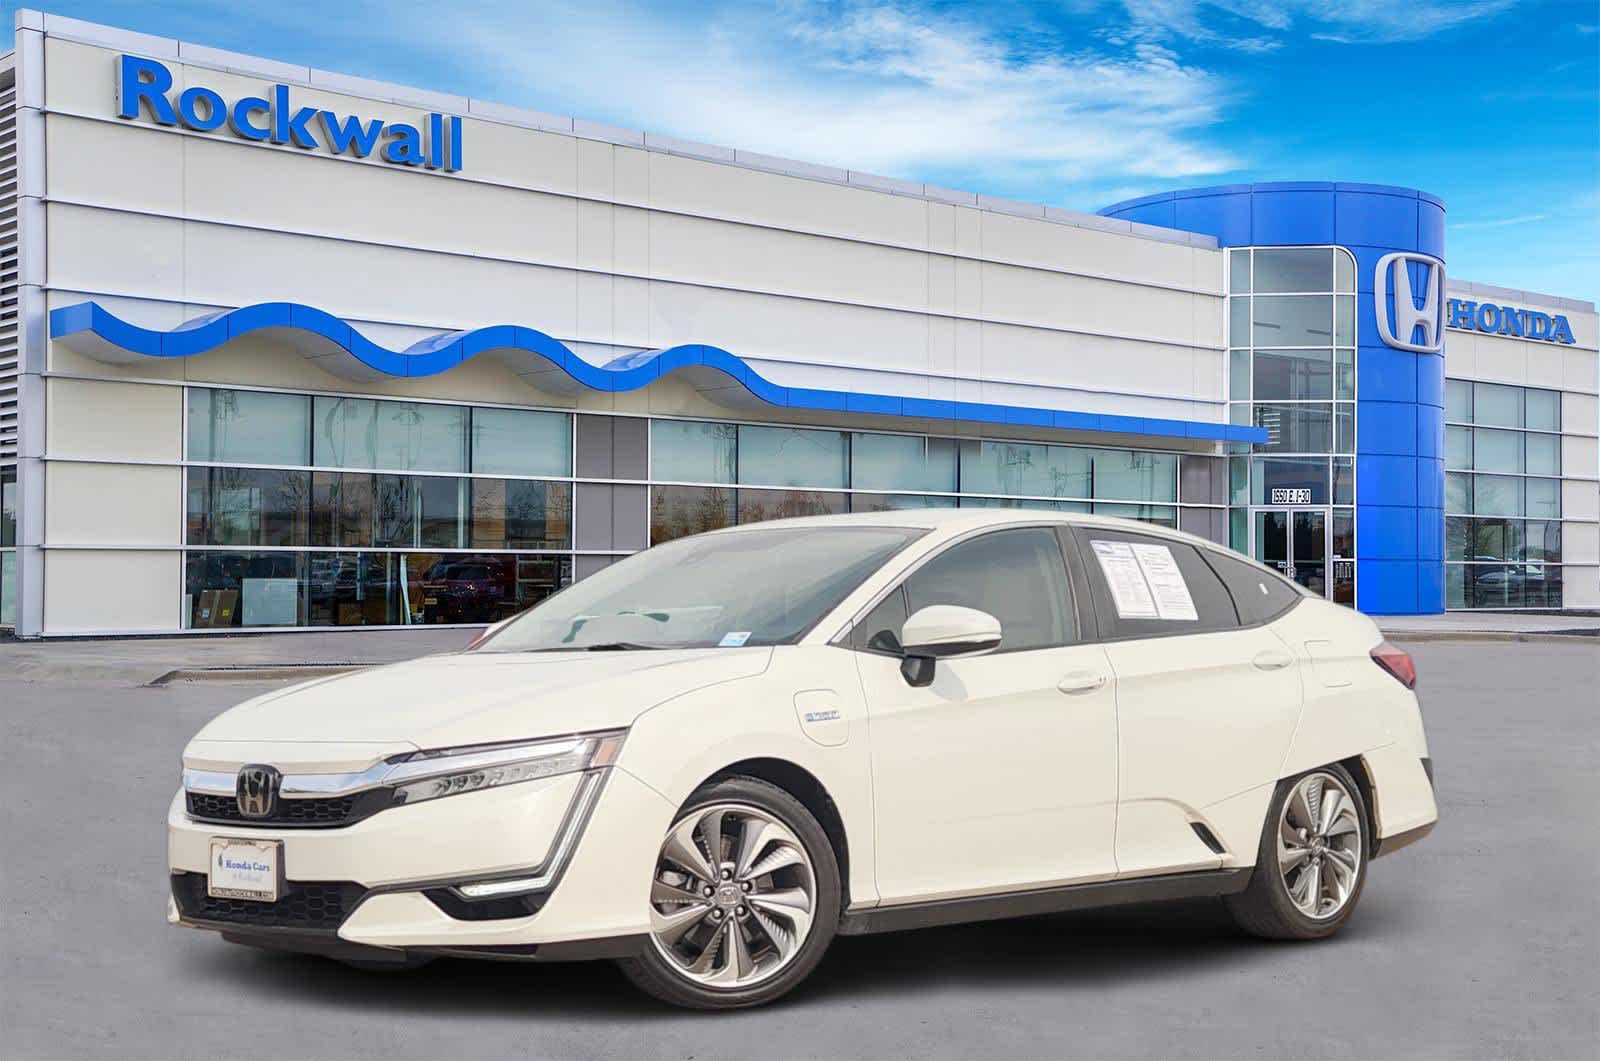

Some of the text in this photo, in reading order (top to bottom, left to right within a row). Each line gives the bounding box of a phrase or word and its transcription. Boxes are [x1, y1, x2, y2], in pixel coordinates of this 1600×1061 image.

[116, 54, 463, 172] Rockwall
[1446, 298, 1577, 344] HONDA
[225, 860, 271, 872] Honda Cars
